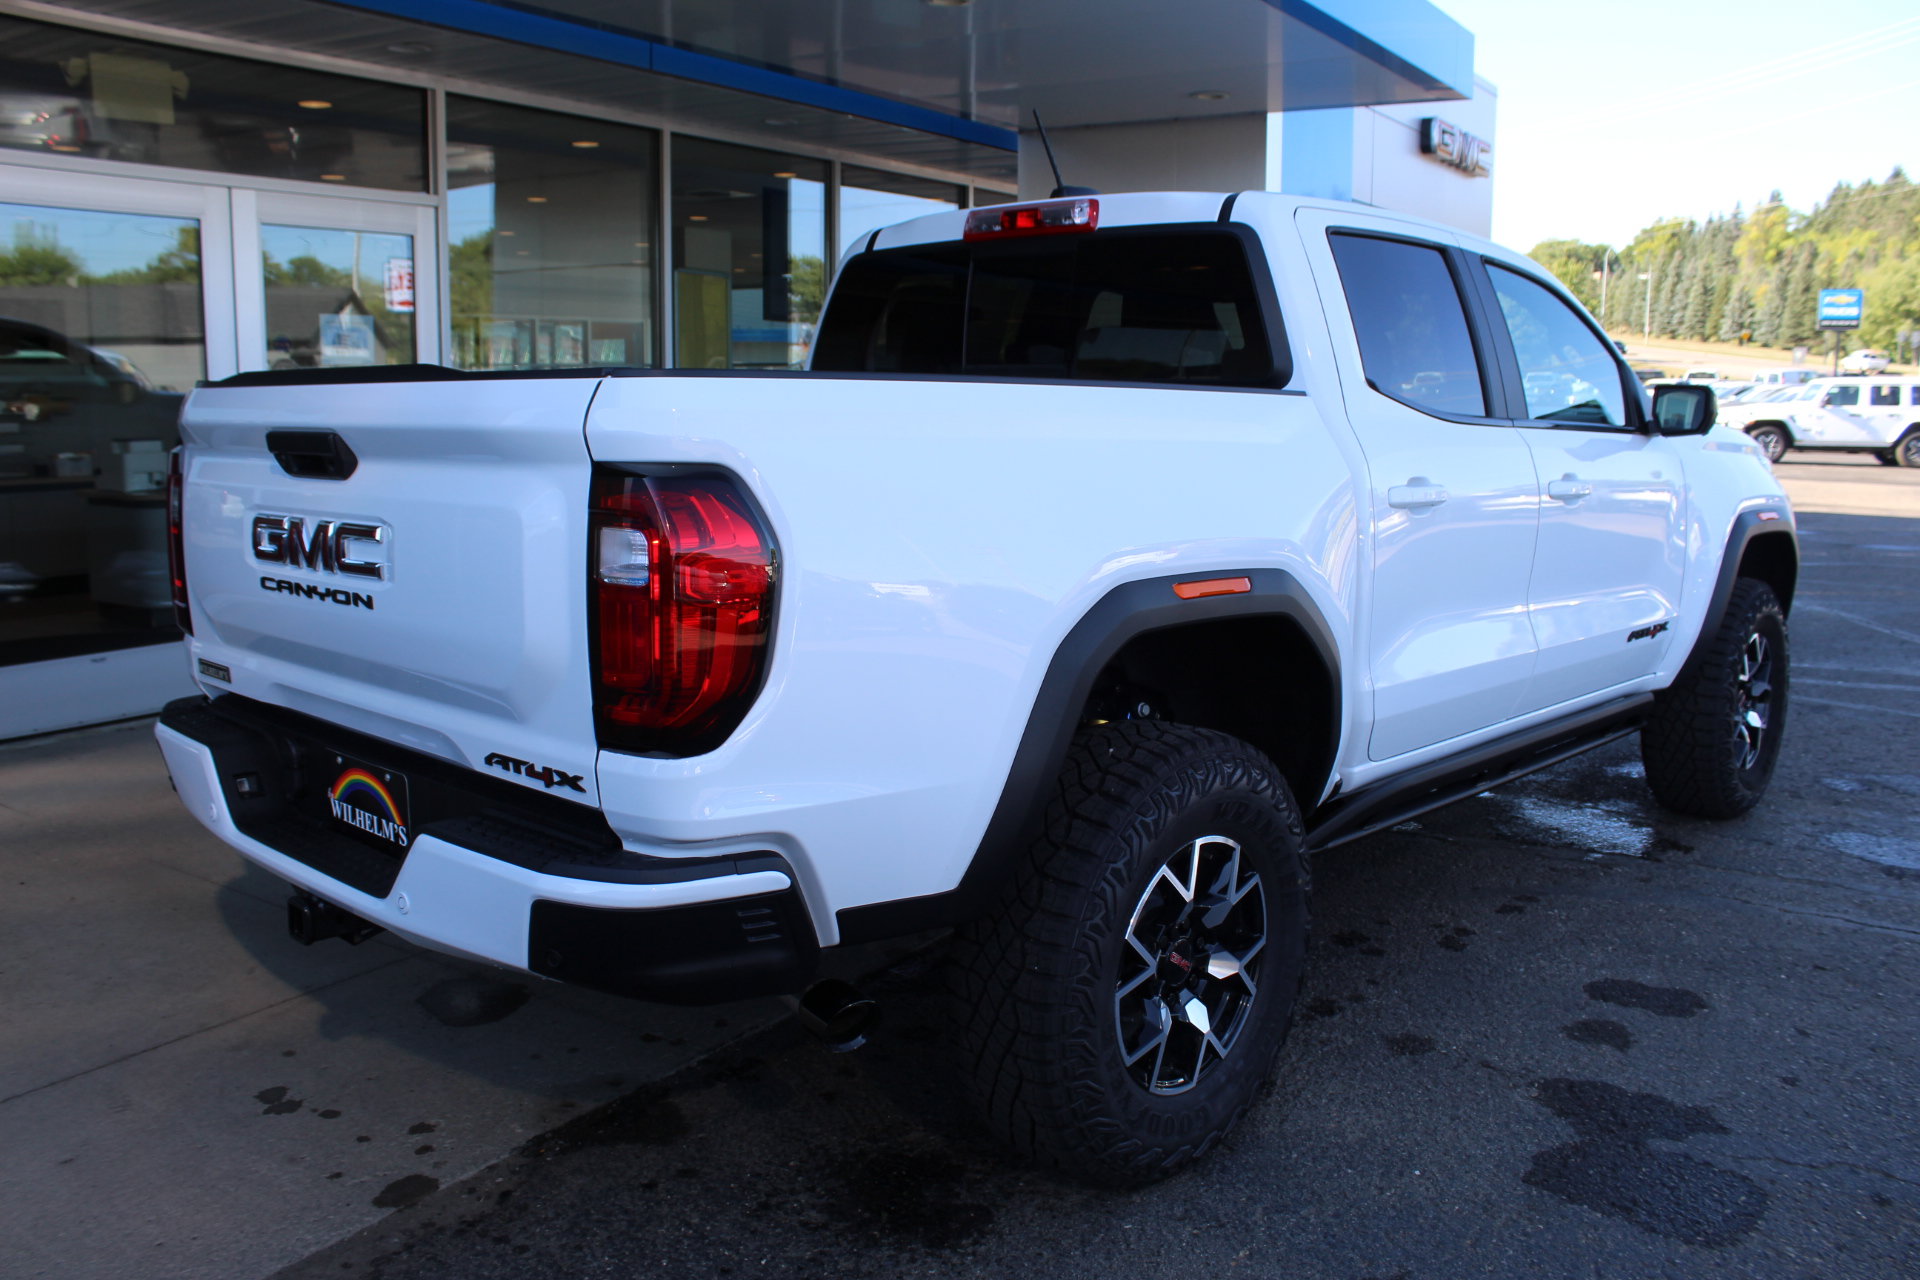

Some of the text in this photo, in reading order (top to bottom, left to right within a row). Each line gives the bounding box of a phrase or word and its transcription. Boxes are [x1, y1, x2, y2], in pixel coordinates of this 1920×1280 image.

[1425, 117, 1491, 176] GMC
[252, 513, 384, 581] GMC
[260, 576, 374, 610] CANYON
[484, 752, 587, 793] AT4X
[330, 797, 408, 846] WILHELM'S
